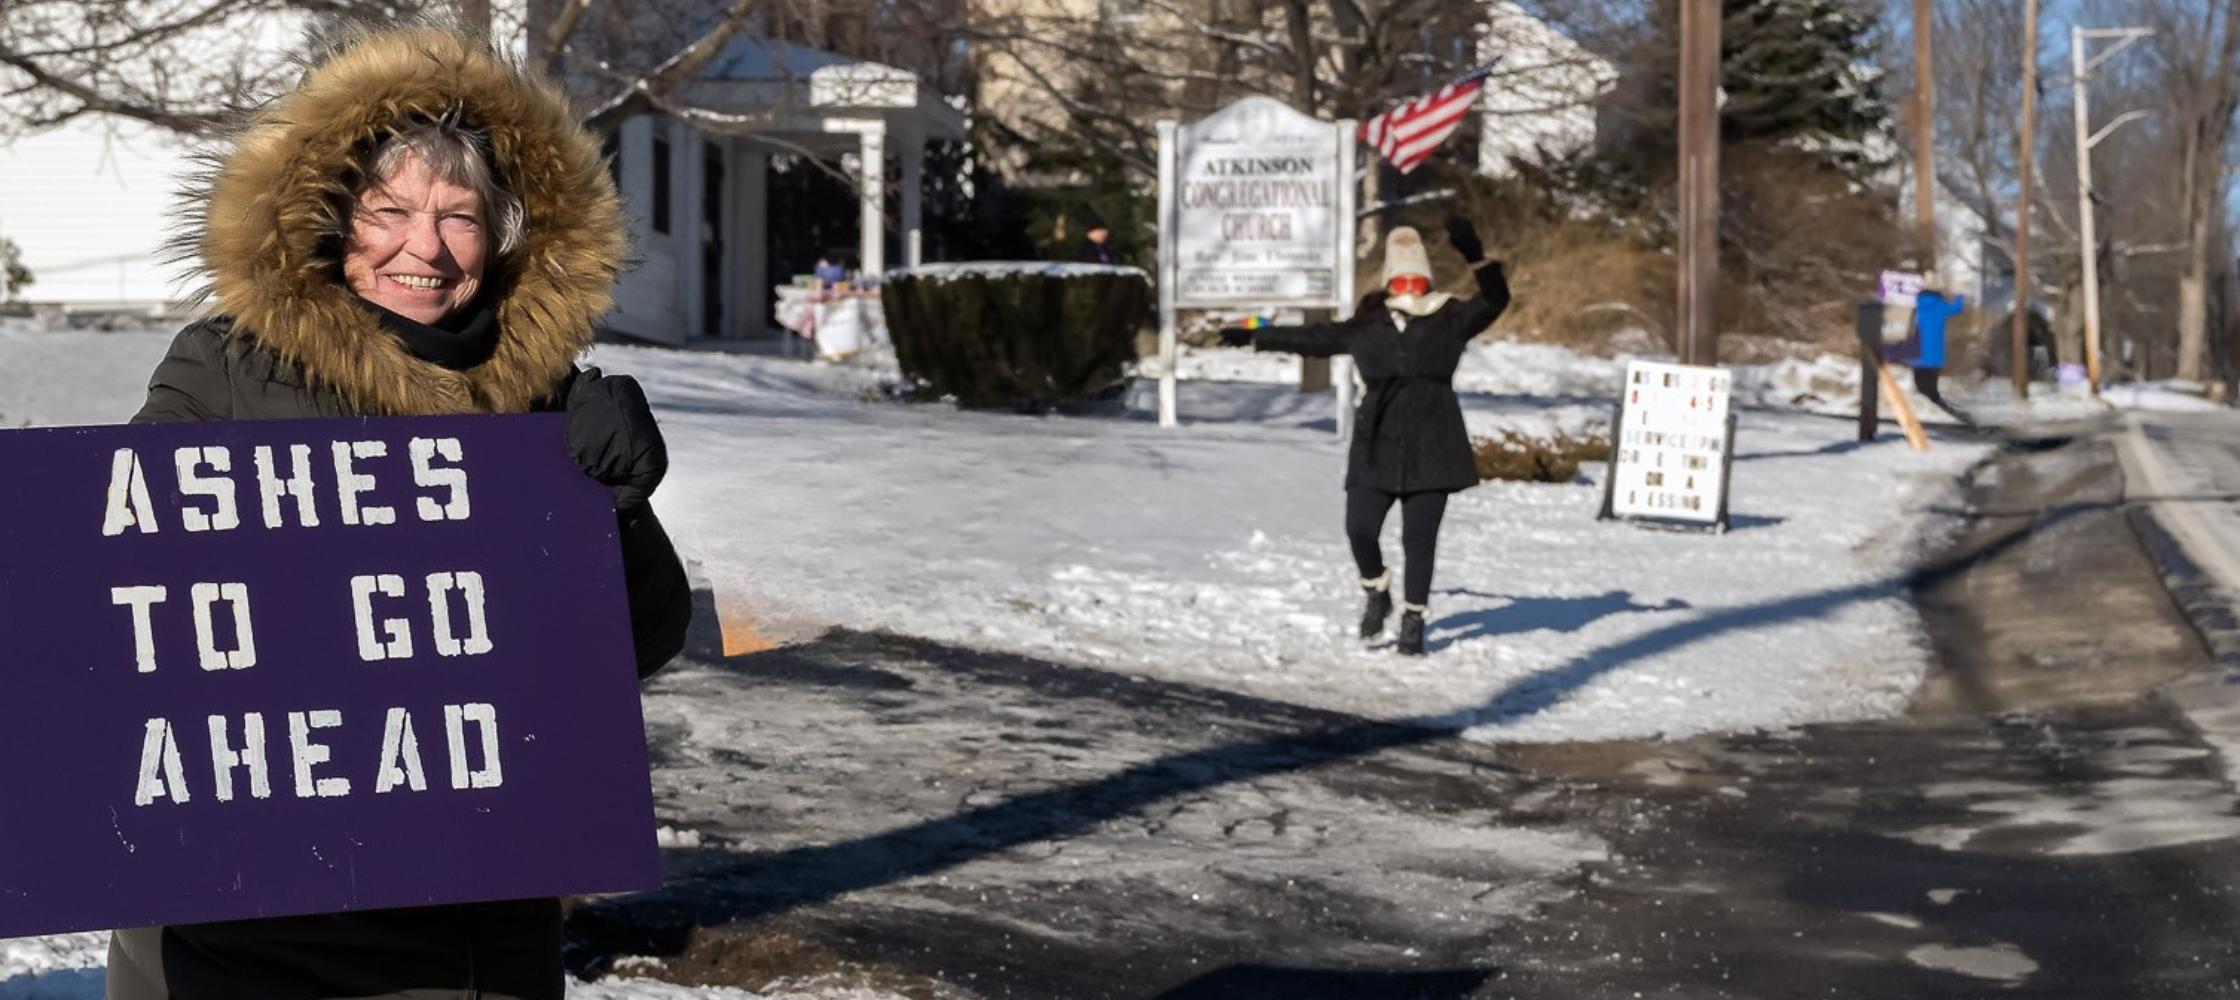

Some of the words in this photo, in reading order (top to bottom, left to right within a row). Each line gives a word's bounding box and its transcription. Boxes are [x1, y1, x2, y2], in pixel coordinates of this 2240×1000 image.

[1204, 157, 1313, 175] ATKINSON
[1182, 181, 1331, 208] CONGREGATIONAL
[1221, 213, 1292, 241] CHURCH
[1633, 370, 1680, 387] ASES
[103, 437, 470, 535] ASHES
[1686, 475, 1694, 489] A
[111, 582, 256, 672] TO
[350, 571, 493, 660] GO
[135, 703, 502, 805] AHEAD
